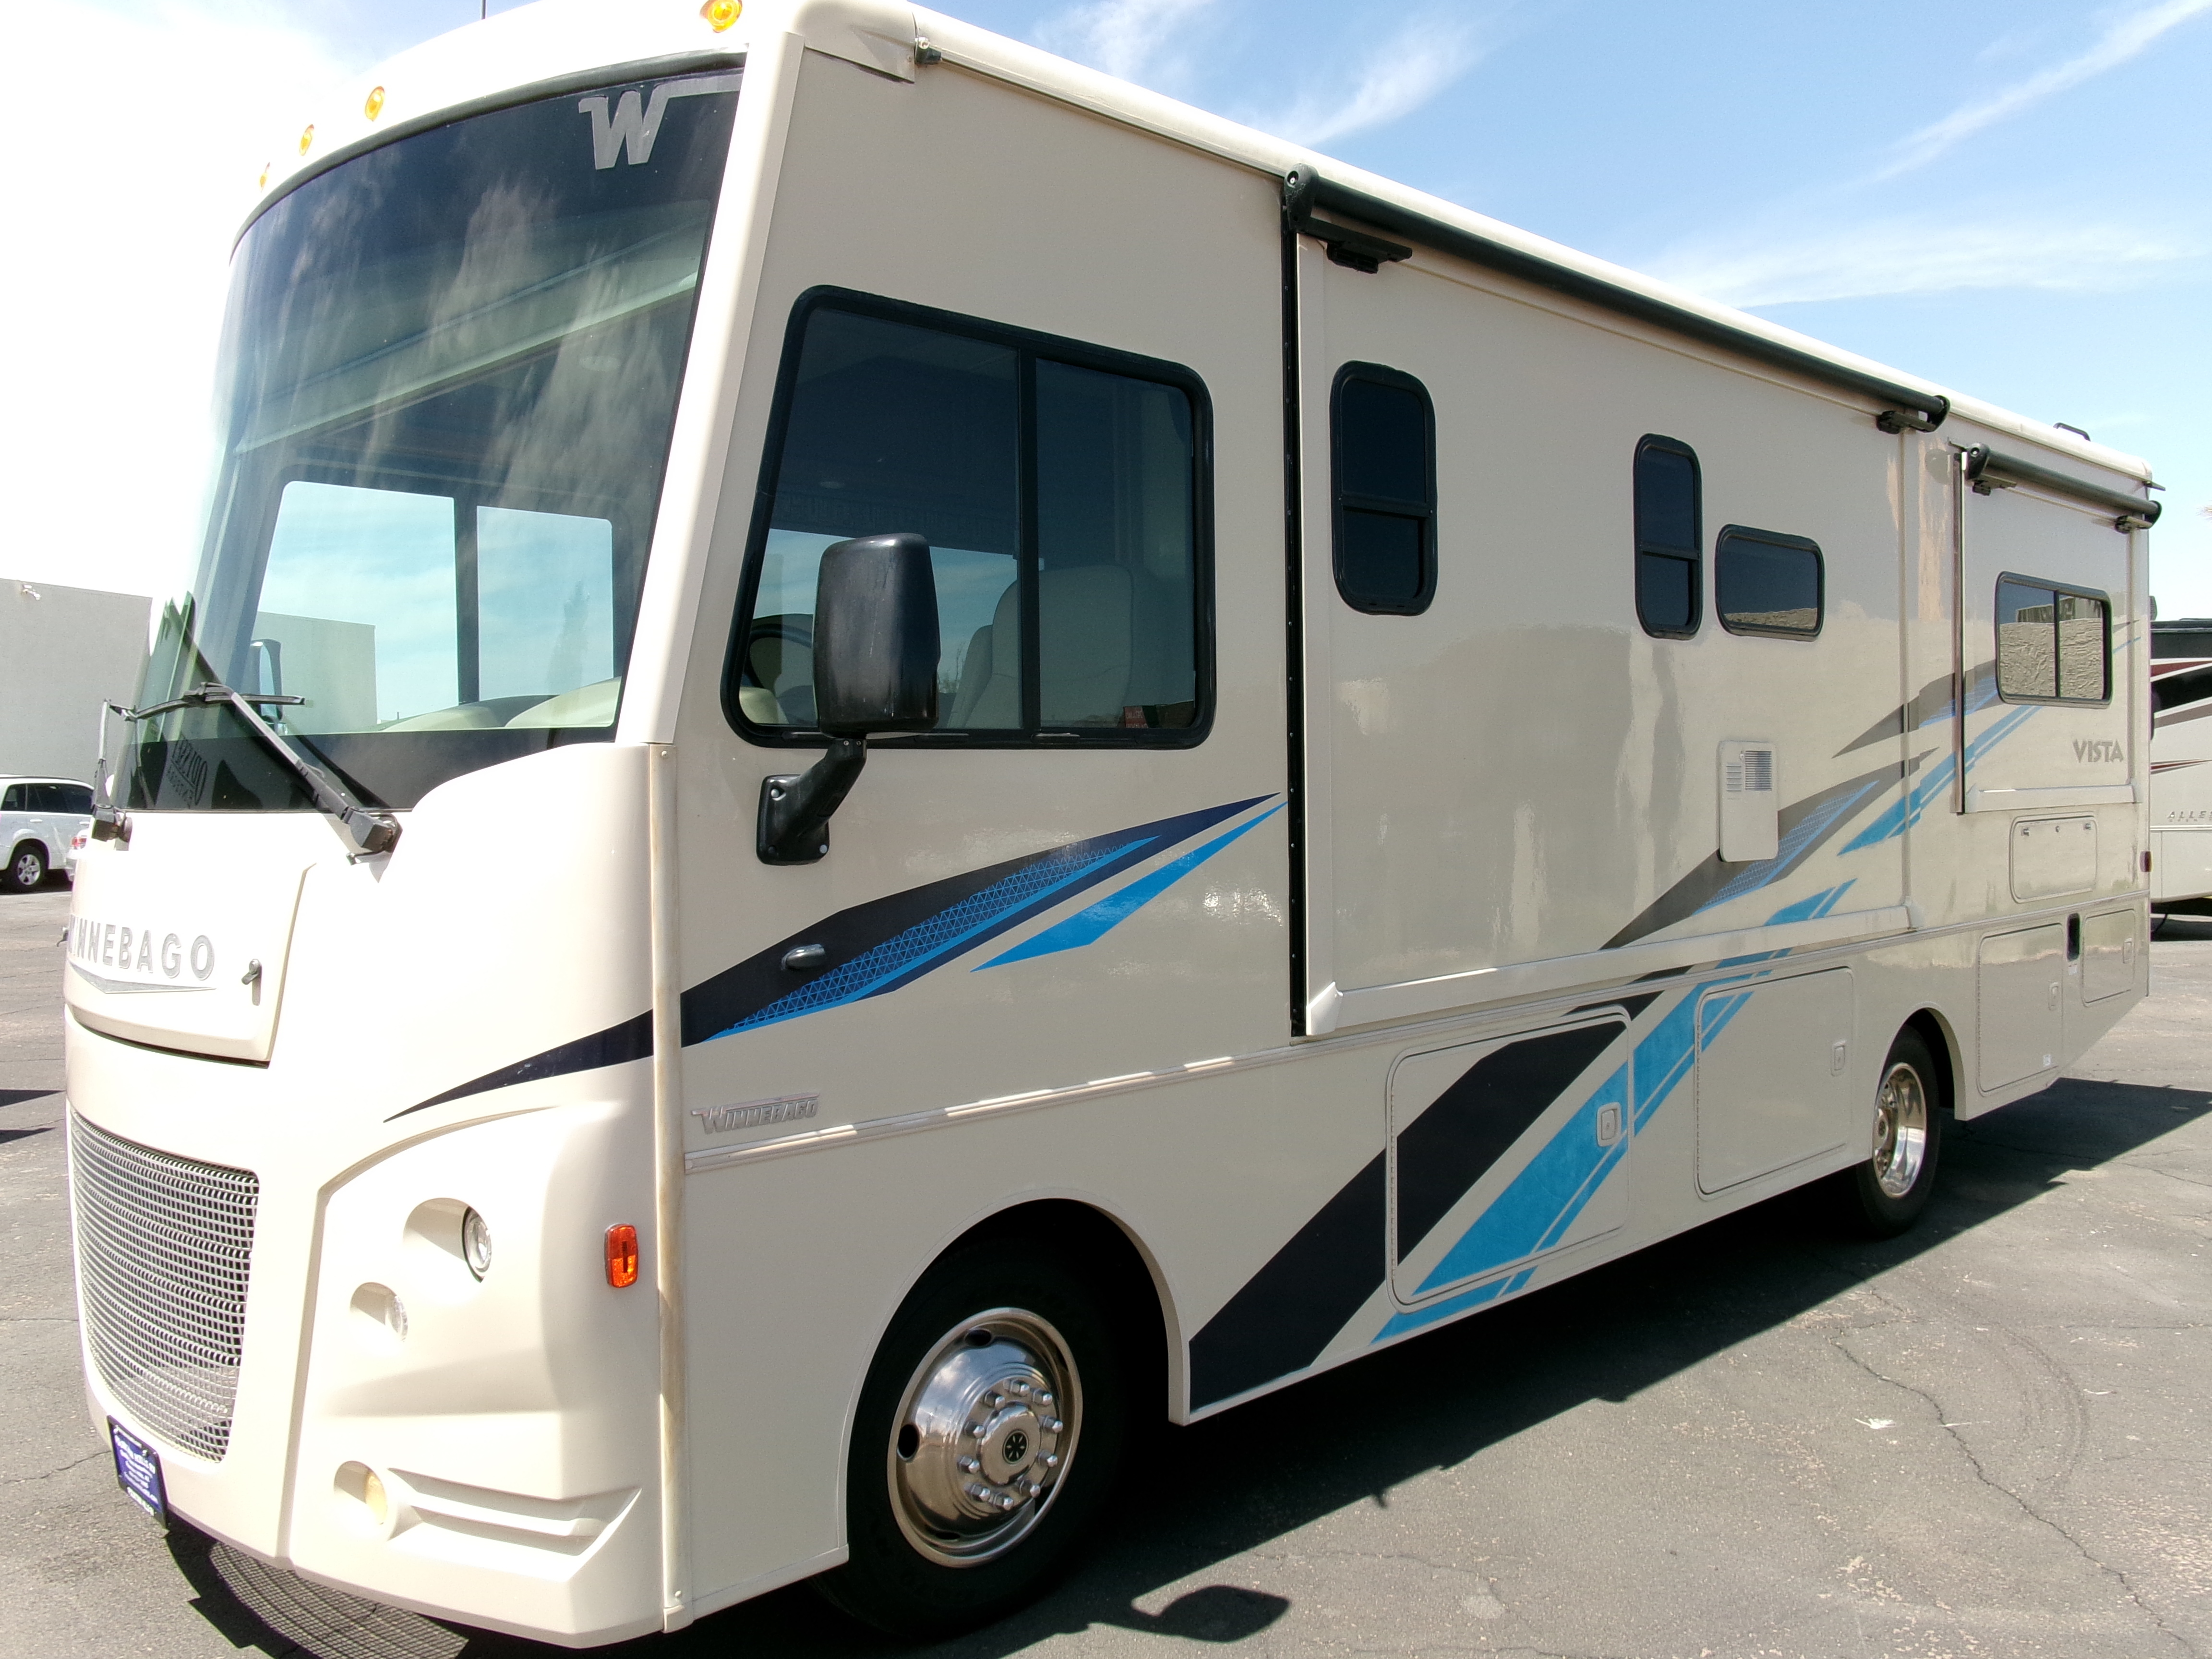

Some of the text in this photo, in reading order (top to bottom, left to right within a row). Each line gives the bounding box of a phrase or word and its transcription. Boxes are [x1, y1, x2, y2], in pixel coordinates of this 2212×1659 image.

[2072, 738, 2124, 763] VISTA
[2167, 810, 2212, 818] ALLE
[691, 1093, 819, 1134] WINNEBAGO
